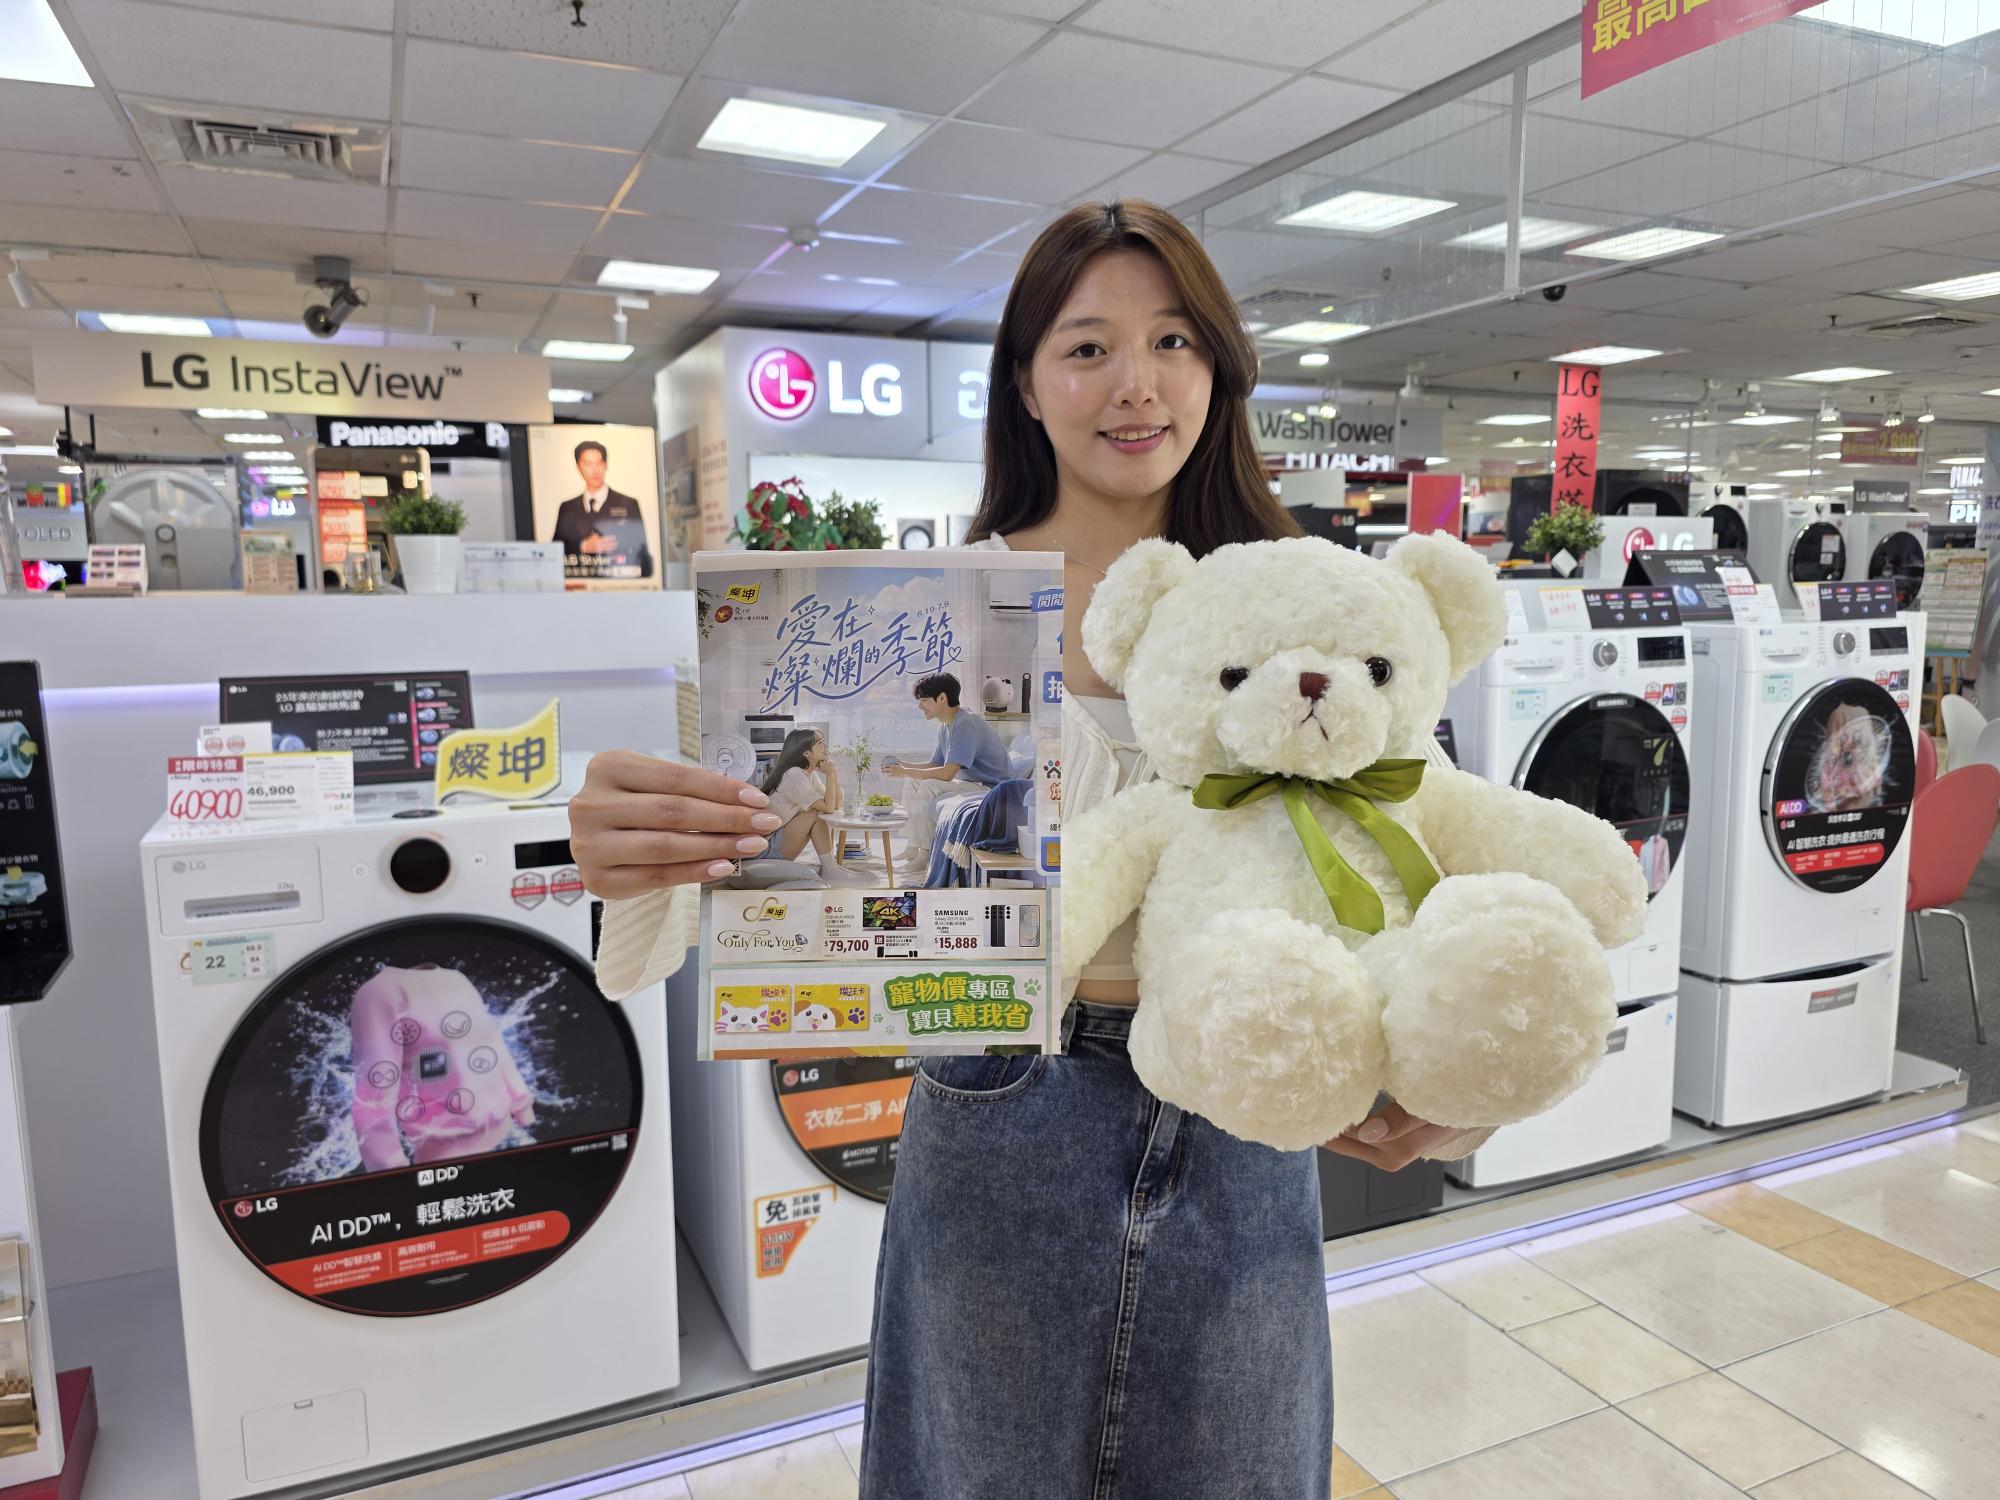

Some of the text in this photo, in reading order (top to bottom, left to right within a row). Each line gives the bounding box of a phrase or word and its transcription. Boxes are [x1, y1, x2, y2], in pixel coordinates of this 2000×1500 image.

[141, 351, 210, 390] LG
[828, 359, 902, 417] LG
[1560, 369, 1599, 397] LG
[329, 420, 459, 447] Panasonic
[1855, 491, 1867, 502] LG
[448, 736, 546, 783] 燦坤
[247, 785, 295, 798] 46,900
[169, 788, 243, 821] 40900
[189, 862, 206, 871] LG
[880, 907, 899, 916] 4K
[724, 936, 795, 951] Only For You
[825, 940, 869, 954] $79,700
[934, 937, 978, 950] $15,888
[205, 955, 227, 969] 22
[888, 976, 1012, 1007] 寵物價專區
[911, 1003, 1029, 1031] 寶貝幫我省
[800, 1068, 819, 1083] LG
[804, 1099, 883, 1132] 衣乾二淨
[255, 1197, 278, 1214] LG
[310, 1225, 333, 1245] AI
[416, 1187, 516, 1226] 輕鬆洗衣
[766, 1200, 788, 1224] 免
